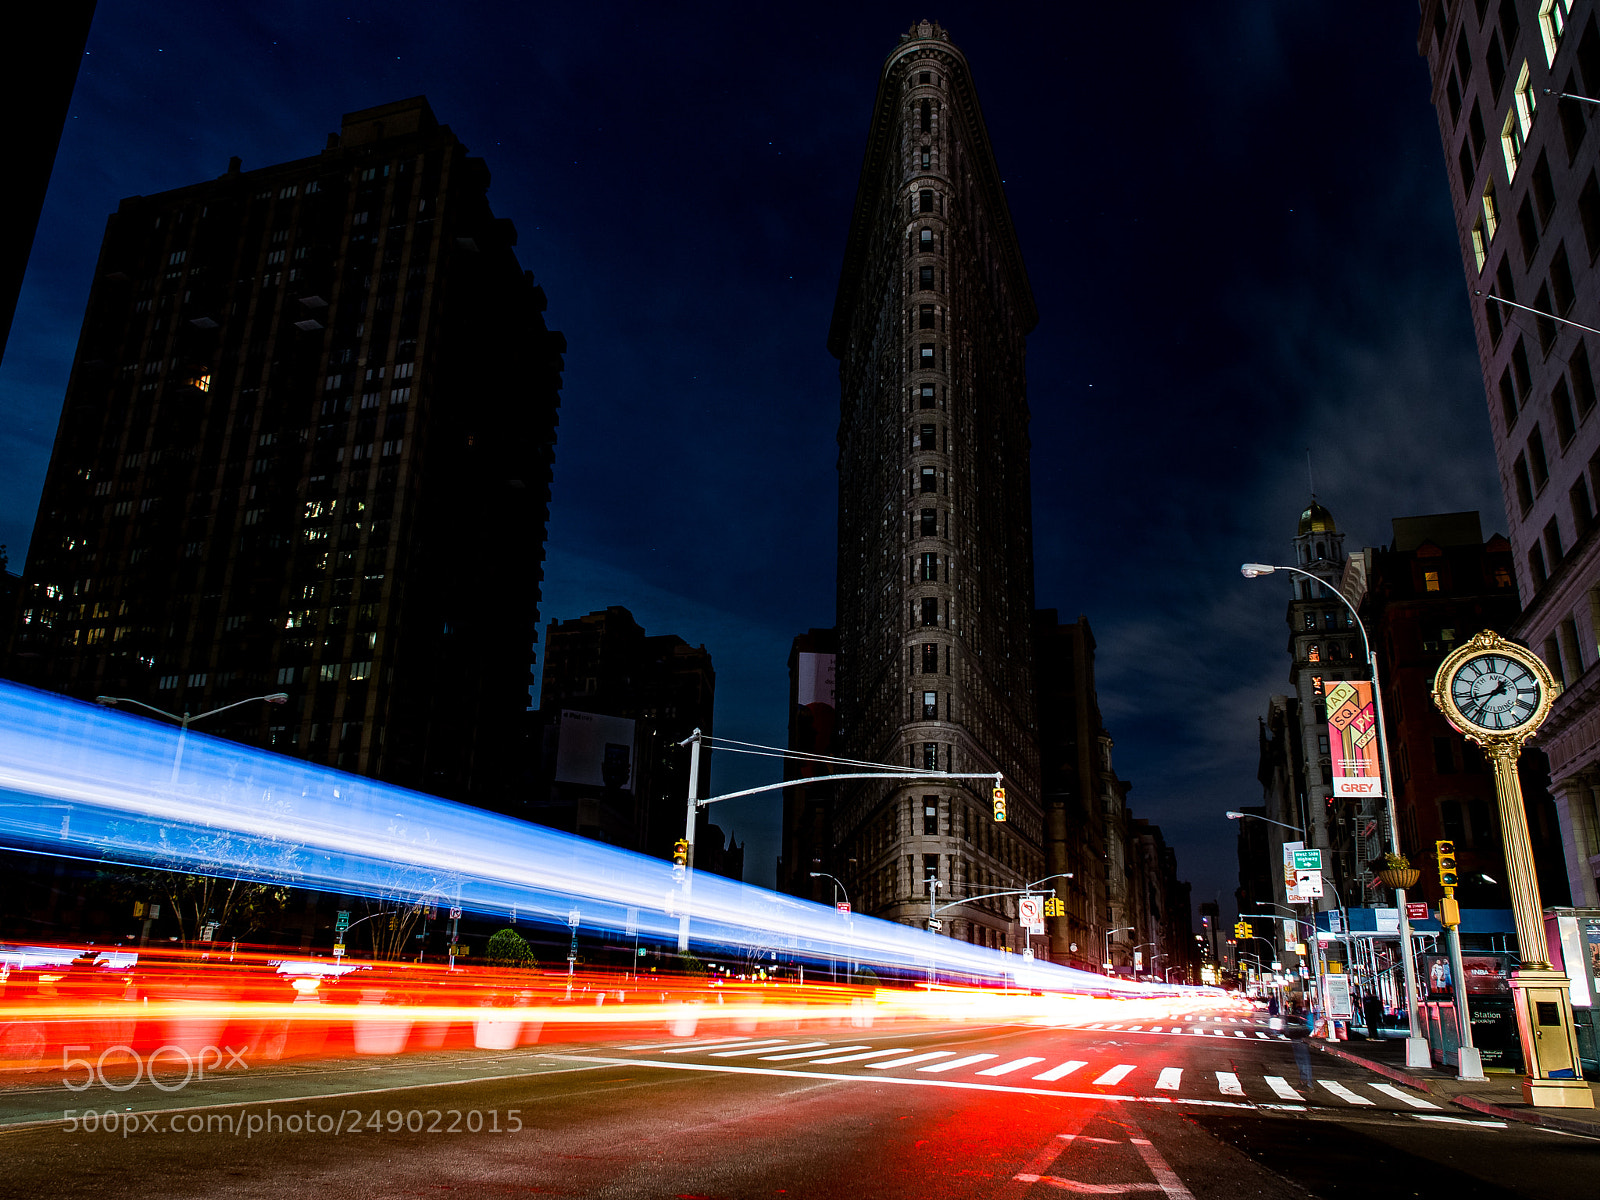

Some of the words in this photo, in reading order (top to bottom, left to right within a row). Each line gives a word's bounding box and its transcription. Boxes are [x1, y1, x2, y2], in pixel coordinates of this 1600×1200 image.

[1480, 699, 1514, 712] BUILDING
[1334, 708, 1357, 726] SQ.
[1355, 709, 1374, 729] PK
[1340, 783, 1374, 793] GREY
[1474, 1011, 1501, 1019] Station
